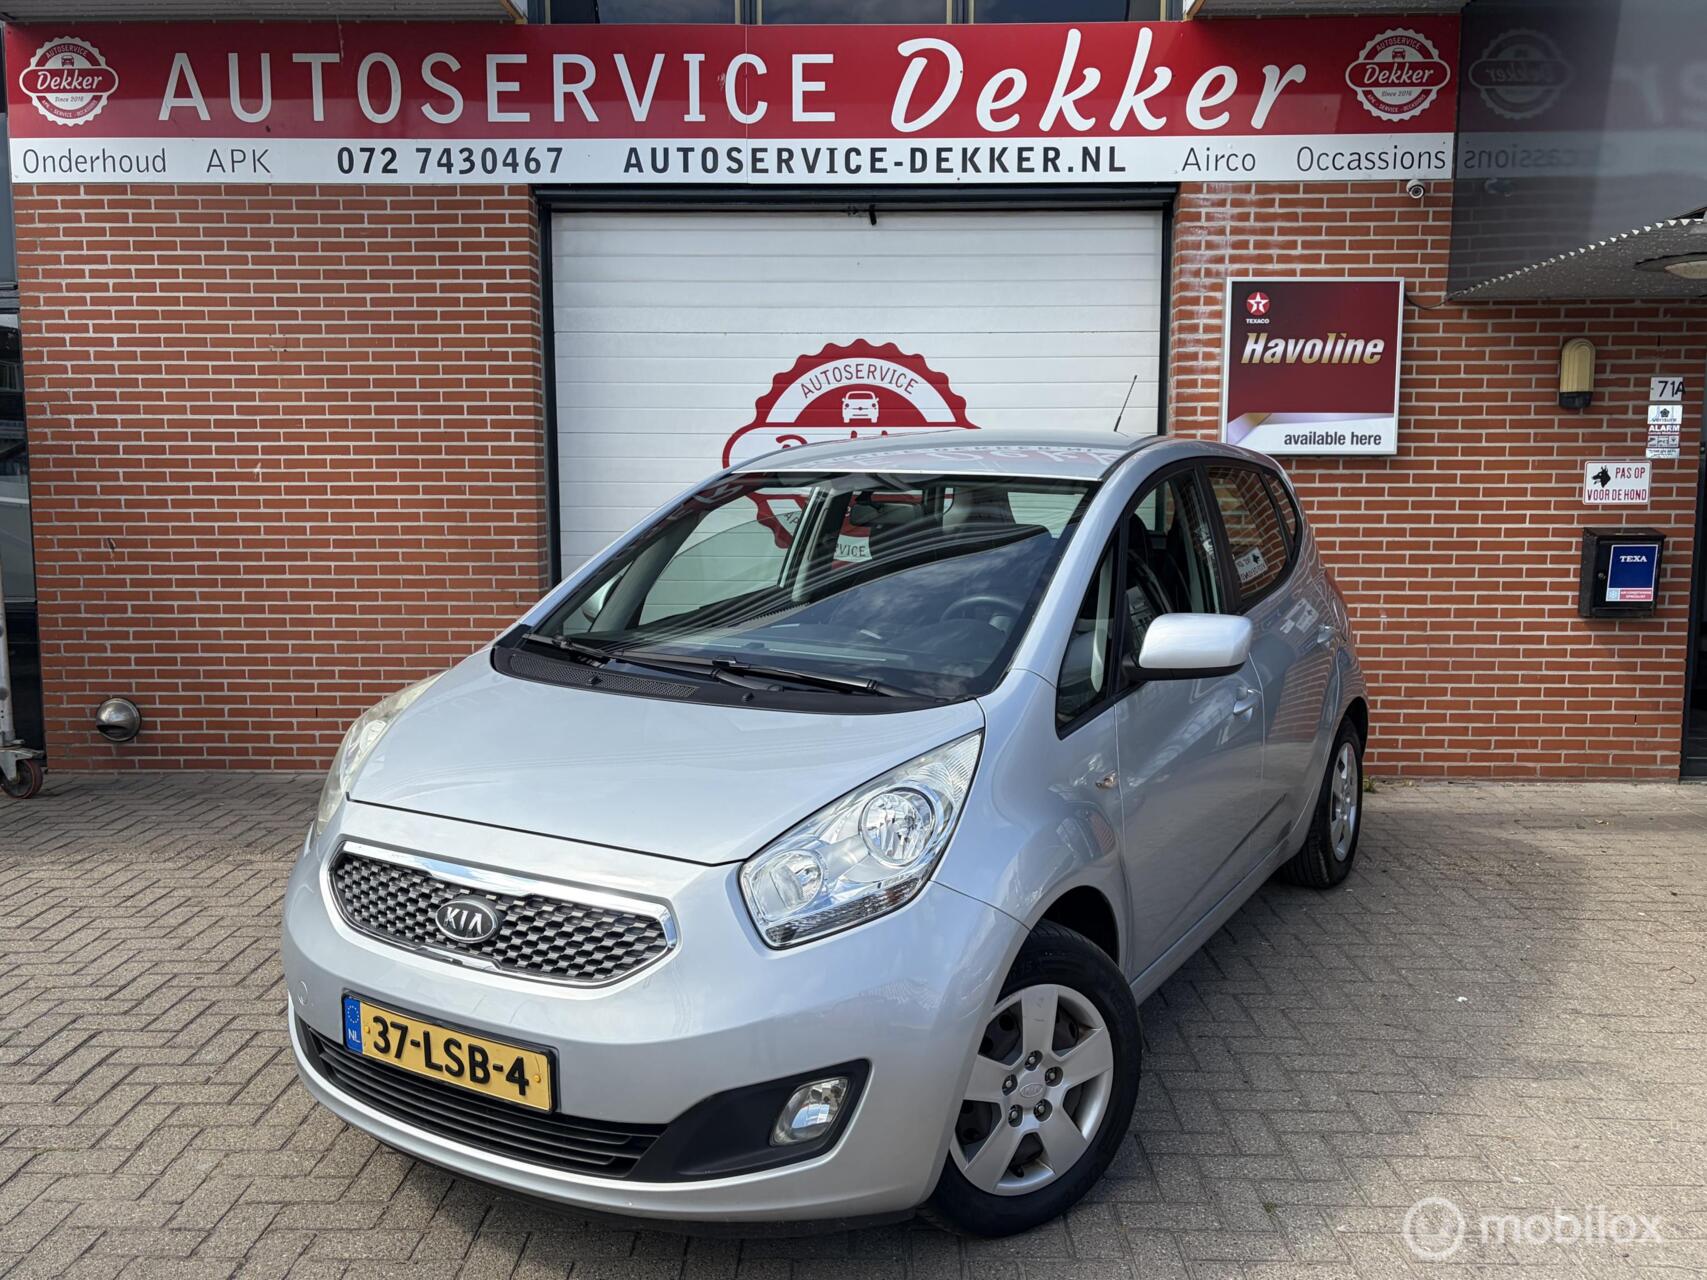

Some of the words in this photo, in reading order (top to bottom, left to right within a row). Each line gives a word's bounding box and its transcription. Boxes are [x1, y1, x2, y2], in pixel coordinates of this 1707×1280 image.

[45, 43, 88, 59] AUTOSERVICE
[1375, 37, 1421, 52] AUTOSERVICE
[36, 69, 103, 90] Dekker
[158, 52, 836, 124] AUTOSERVICE
[890, 27, 1307, 134] Dekker
[1363, 61, 1434, 84] Dekker
[22, 147, 167, 174] Onderhoud
[206, 148, 272, 174] APK
[337, 146, 398, 174] 072
[415, 146, 564, 174] 7430467
[623, 146, 1127, 174] AUTOSERVICE-DEKKER.NL
[1181, 146, 1256, 172] Airco
[1296, 144, 1446, 171] Occassions
[1241, 332, 1385, 364] Havoline
[800, 363, 919, 400] AUTOSERVICE
[1658, 380, 1686, 398] 71A
[1648, 424, 1680, 432] ALARM
[1283, 431, 1346, 446] available
[1350, 431, 1382, 446] here
[1615, 467, 1632, 479] PAS
[1634, 467, 1646, 479] OP
[1587, 489, 1610, 501] VOOR
[1611, 489, 1623, 501] DE
[1624, 489, 1647, 501] HOND
[1619, 555, 1648, 563] TEXA
[446, 905, 483, 936] KIA
[348, 1028, 360, 1043] NL
[372, 1015, 530, 1097] 37-LSB-4
